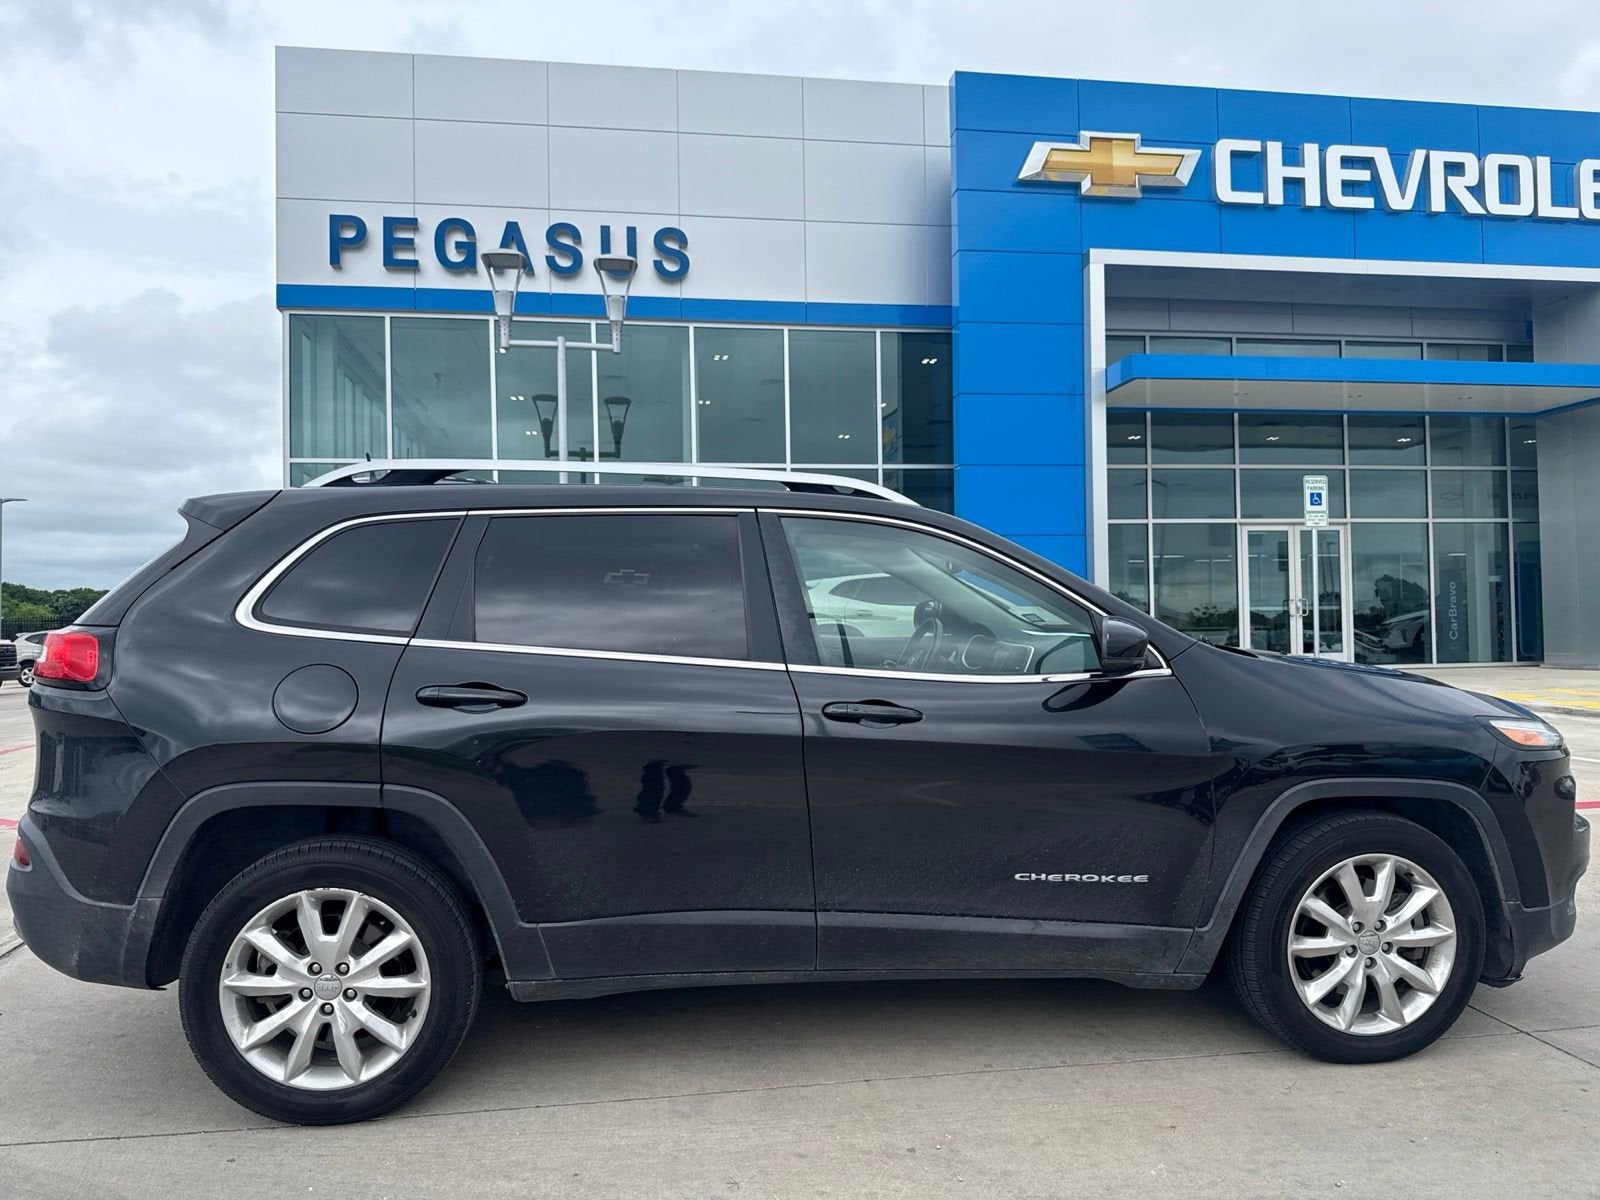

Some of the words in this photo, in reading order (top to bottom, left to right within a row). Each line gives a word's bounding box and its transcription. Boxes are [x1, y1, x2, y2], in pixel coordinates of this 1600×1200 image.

[329, 213, 691, 282] PEGASUS
[1448, 581, 1458, 640] CarBravo
[1014, 873, 1149, 883] CHEROKEE
